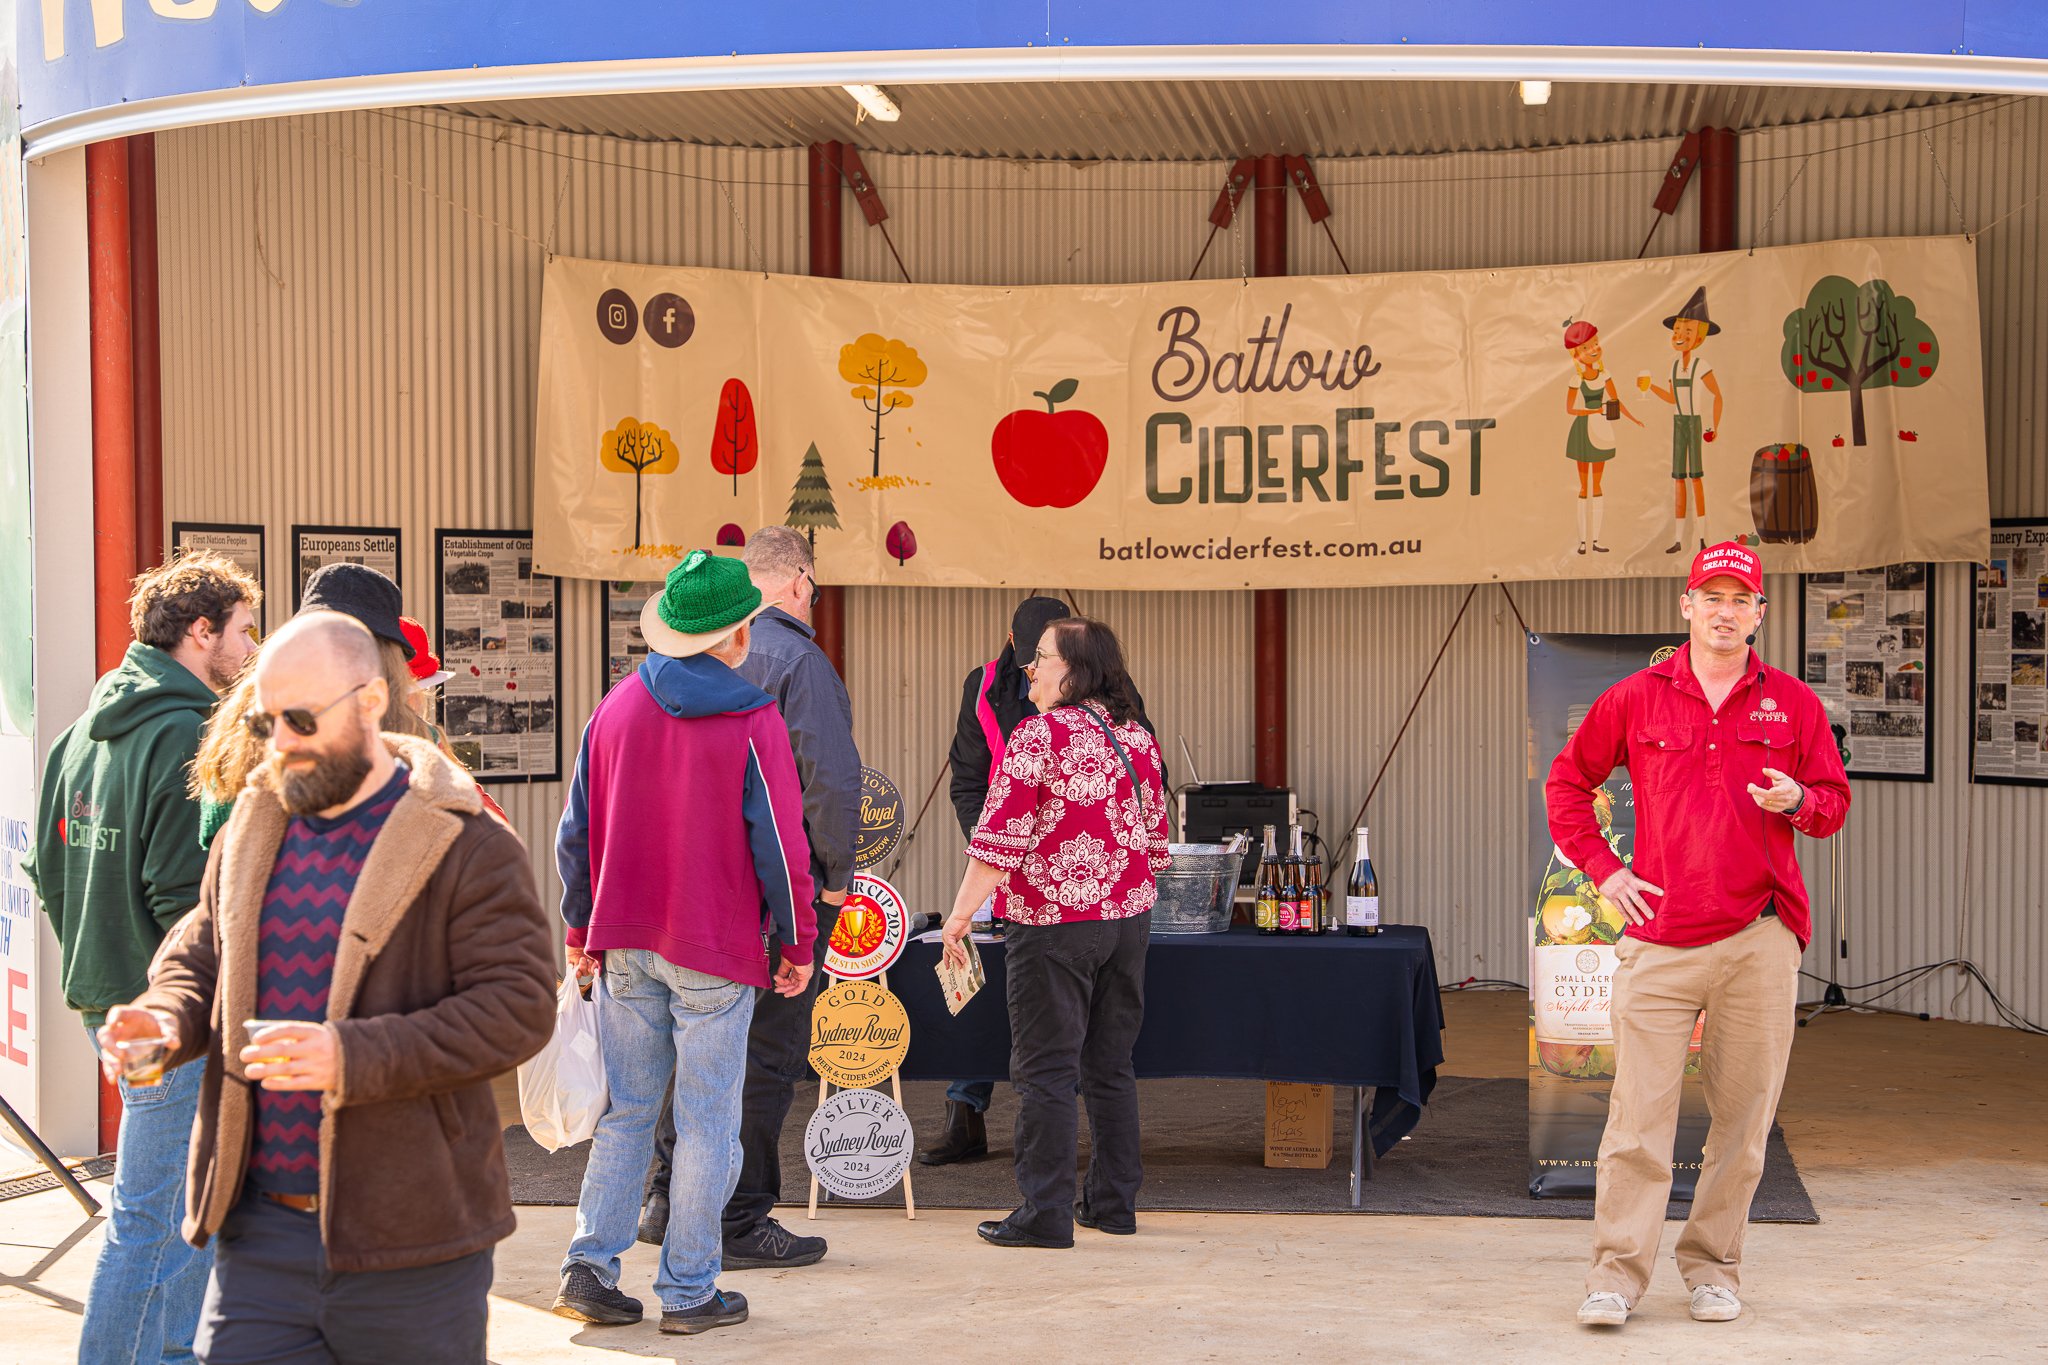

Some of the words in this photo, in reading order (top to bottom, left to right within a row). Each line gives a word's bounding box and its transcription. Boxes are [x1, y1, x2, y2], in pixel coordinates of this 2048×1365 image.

[1152, 303, 1382, 402] Batlow
[1146, 407, 1496, 504] CIDERFEST
[206, 536, 225, 545] Nation
[226, 537, 248, 547] Peoples
[300, 537, 361, 554] Europeans
[363, 538, 395, 553] Settle
[444, 539, 504, 550] Establishment
[505, 540, 514, 550] of
[1098, 535, 1423, 561] batlowciderfest.com.au
[1991, 533, 2022, 547] nnery
[450, 550, 477, 558] Vegetable
[477, 551, 494, 559] Crops
[1702, 549, 1725, 561] MAKE
[1725, 548, 1754, 565] APPLES
[1702, 559, 1729, 572] GREAT
[1728, 560, 1752, 574] AGAIN
[1749, 715, 1789, 723] CYDER
[860, 796, 898, 827] Royal
[869, 836, 890, 858] SHOW
[868, 884, 894, 908] CUP
[884, 909, 900, 948] 2024
[828, 954, 849, 970] BEST
[861, 952, 885, 969] SHOW
[1554, 975, 1586, 983] SMALL
[828, 989, 885, 1007] GOLD
[1555, 985, 1608, 997] CYDE
[1545, 1000, 1589, 1020] Norfolk
[811, 1016, 863, 1051] Sydney
[862, 1014, 904, 1047] Royal
[839, 1050, 866, 1062] 2024
[816, 1056, 833, 1074] BEER
[832, 1070, 840, 1078] &
[841, 1073, 867, 1081] CIDER
[868, 1059, 891, 1079] SHOW
[825, 1098, 894, 1122] SILVER
[810, 1127, 865, 1163] Sydney
[863, 1122, 907, 1155] Royal
[820, 1166, 855, 1189] DISTILLED
[855, 1177, 884, 1189] SPIRITS
[884, 1160, 902, 1180] SHOW
[843, 1162, 870, 1173] 2024
